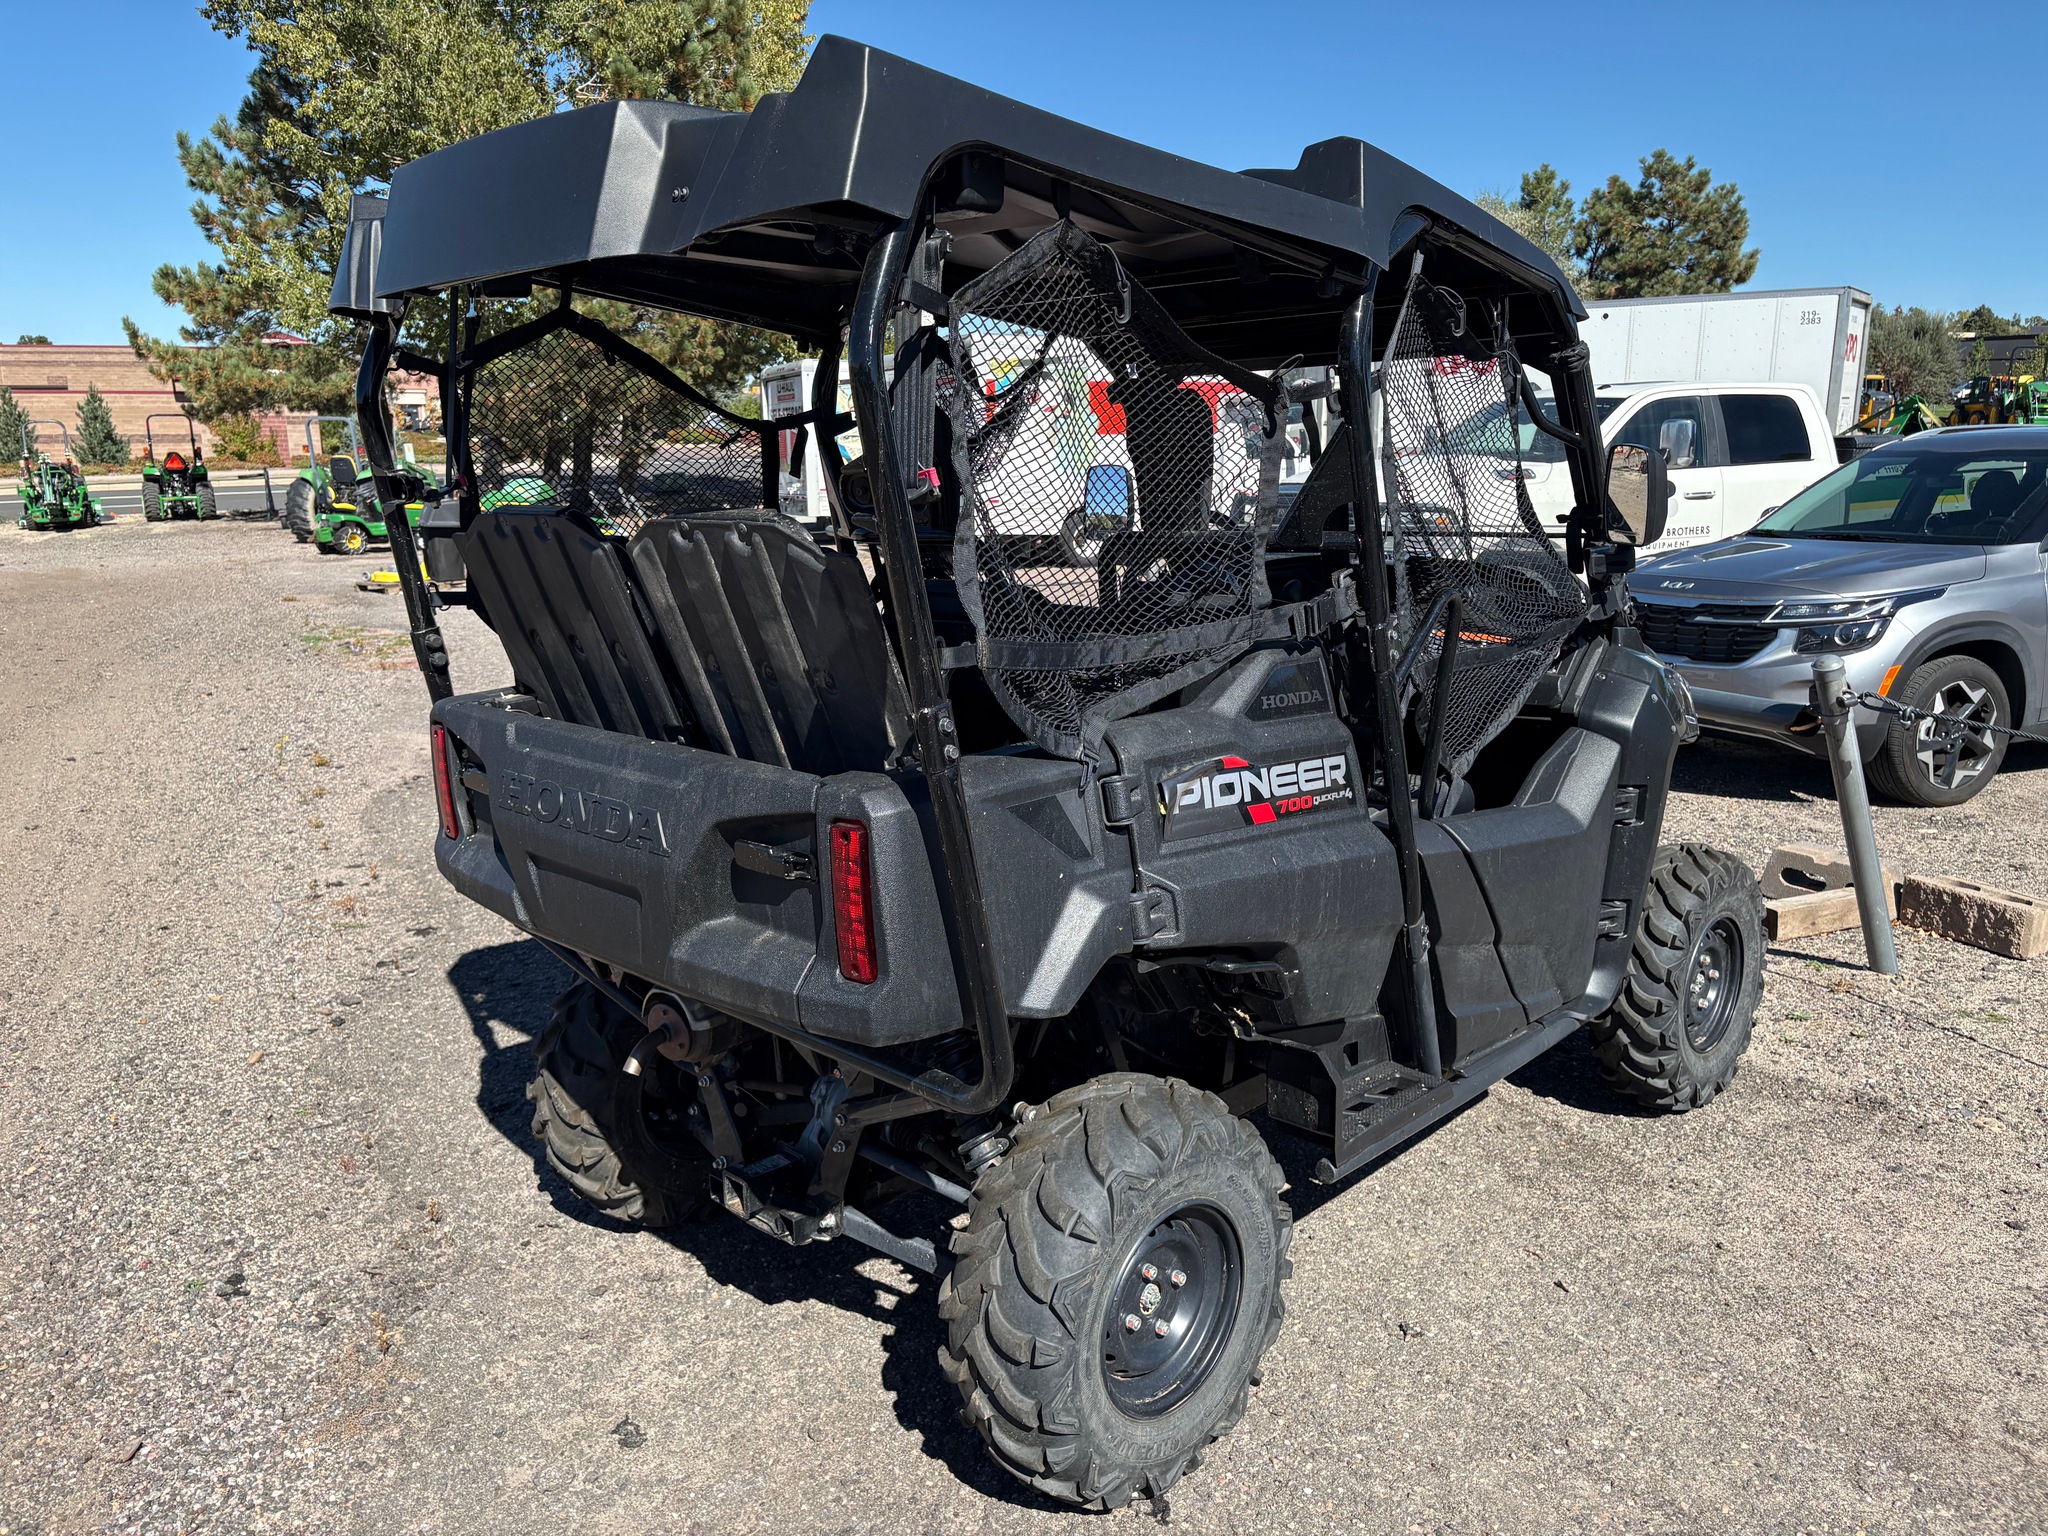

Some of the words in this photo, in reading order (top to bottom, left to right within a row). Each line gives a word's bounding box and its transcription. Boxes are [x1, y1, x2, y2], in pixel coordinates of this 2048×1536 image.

[1800, 317, 1821, 325] 2383
[1801, 310, 1820, 318] 319-
[1667, 526, 1710, 536] BROTHERS
[1261, 690, 1323, 709] HONDA
[1173, 754, 1347, 814] PIONEER
[499, 769, 671, 858] HONDA
[1276, 795, 1312, 814] 700
